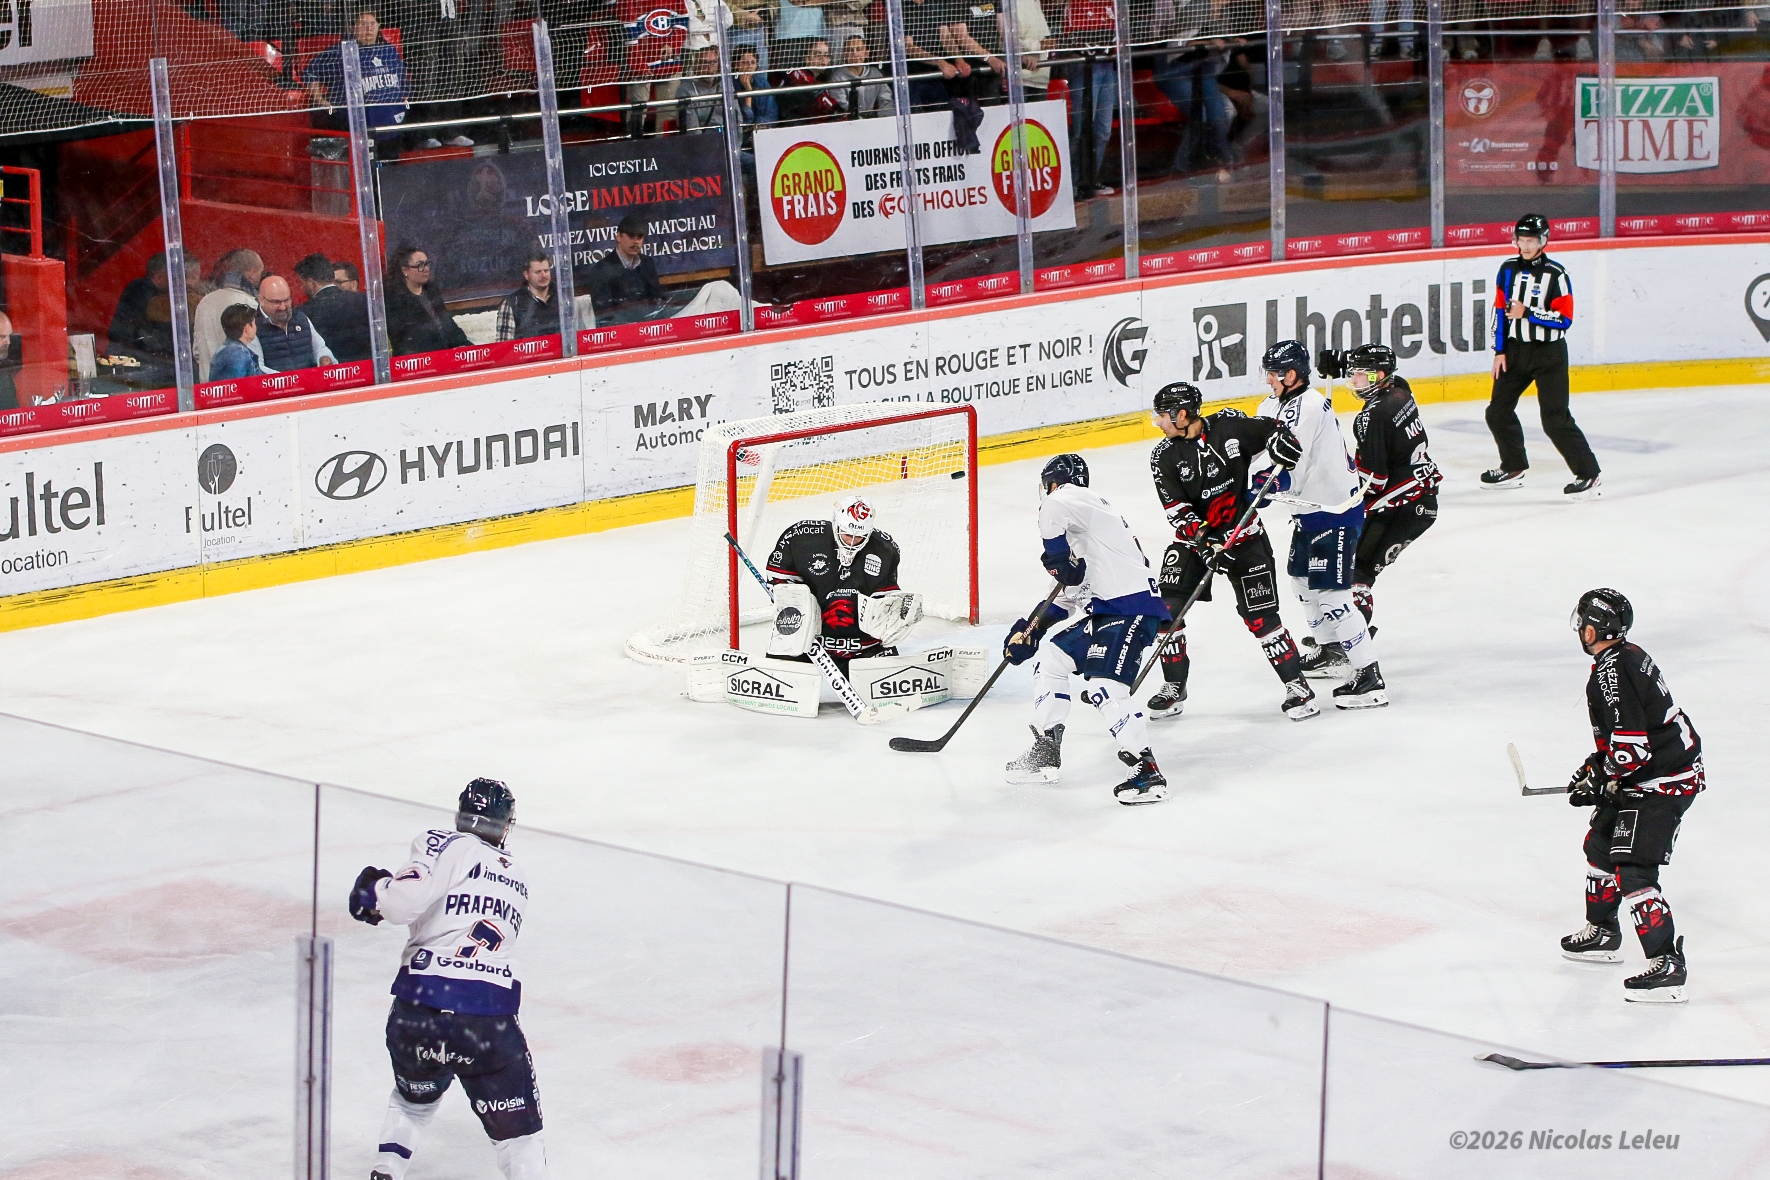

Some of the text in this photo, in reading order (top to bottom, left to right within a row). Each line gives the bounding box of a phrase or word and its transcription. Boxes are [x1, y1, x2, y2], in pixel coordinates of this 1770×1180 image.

[1586, 85, 1710, 117] PIZZA
[1584, 118, 1711, 162] TIME
[851, 142, 931, 168] FOURNISSUR
[589, 164, 614, 178] ICI
[643, 157, 659, 172] LA
[781, 168, 835, 196] GRAND
[865, 164, 966, 192] DES FRTS FRAIS
[525, 175, 723, 218] LOGE IMMERSION
[782, 191, 838, 220] FRAIS
[852, 200, 875, 219] DES
[1554, 220, 1590, 232] somme
[1620, 218, 1658, 230] somme
[1676, 216, 1714, 227] somme
[1731, 214, 1769, 225] somme
[586, 225, 619, 243] VIVR
[648, 217, 697, 236] MATCH
[698, 214, 717, 230] AU
[1387, 230, 1421, 243] somme
[1448, 226, 1484, 239] somme
[653, 242, 671, 256] LA
[1288, 239, 1322, 252] somme
[1338, 235, 1372, 247] somme
[1188, 250, 1220, 263] somme
[1233, 245, 1264, 258] somme
[1085, 262, 1116, 276] somme
[1143, 255, 1174, 269] somme
[977, 275, 1009, 290] somme
[1040, 268, 1071, 282] somme
[867, 291, 900, 305] somme
[931, 283, 963, 298] somme
[814, 299, 847, 313] somme
[639, 322, 673, 337] somme
[694, 315, 729, 329] somme
[1265, 279, 1486, 368] Lhotelli
[582, 329, 617, 344] somme
[513, 339, 549, 354] somme
[395, 355, 432, 371] somme
[454, 347, 491, 363] somme
[844, 363, 897, 391] TOUS
[904, 359, 930, 382] EN
[935, 347, 1000, 377] ROUGE
[1006, 343, 1032, 366] ET
[1038, 335, 1082, 363] NOIR
[323, 365, 360, 381] somme
[200, 382, 238, 398] somme
[262, 374, 299, 390] somme
[941, 377, 1021, 404] BOUTIQUE
[1026, 373, 1046, 393] EN
[1051, 367, 1093, 389] LIGNE
[61, 401, 101, 417] somme
[126, 393, 166, 409] somme
[400, 421, 580, 484] HYUNDAI
[721, 653, 748, 665] CCM
[927, 650, 954, 662] CCM
[1114, 645, 1129, 676] ANGERS
[730, 677, 785, 698] SICRAL
[879, 675, 942, 695] SICRAL
[437, 956, 513, 979] Goubard
